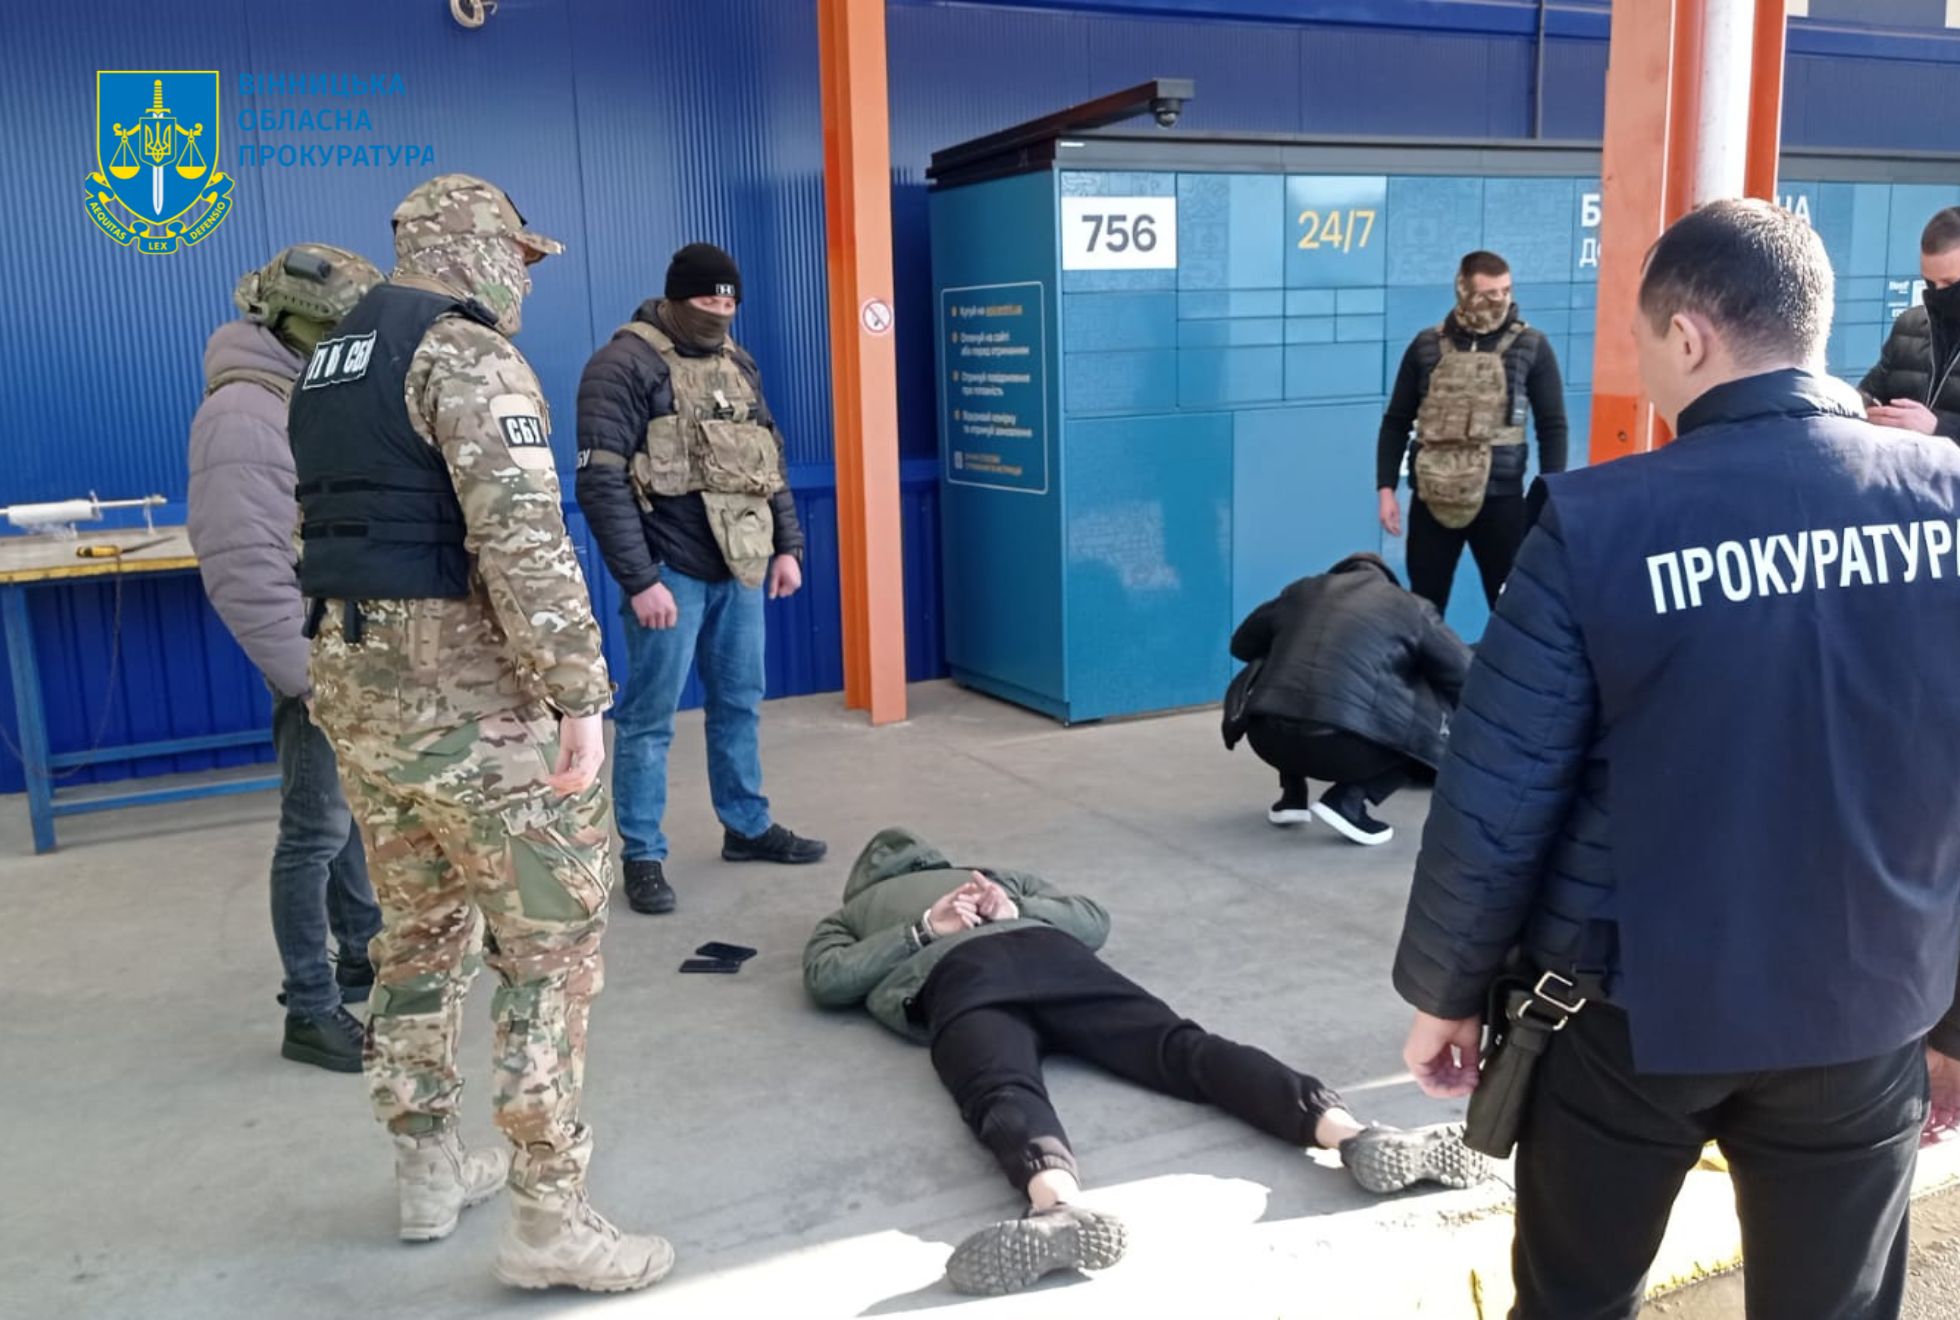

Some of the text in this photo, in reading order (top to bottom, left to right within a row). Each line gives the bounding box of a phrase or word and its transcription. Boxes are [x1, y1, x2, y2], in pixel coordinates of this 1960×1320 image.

[1081, 213, 1158, 253] 756
[1297, 209, 1377, 254] 24/7
[507, 417, 540, 444] СБУ
[1646, 518, 1960, 614] ПРОКУРАТУР
